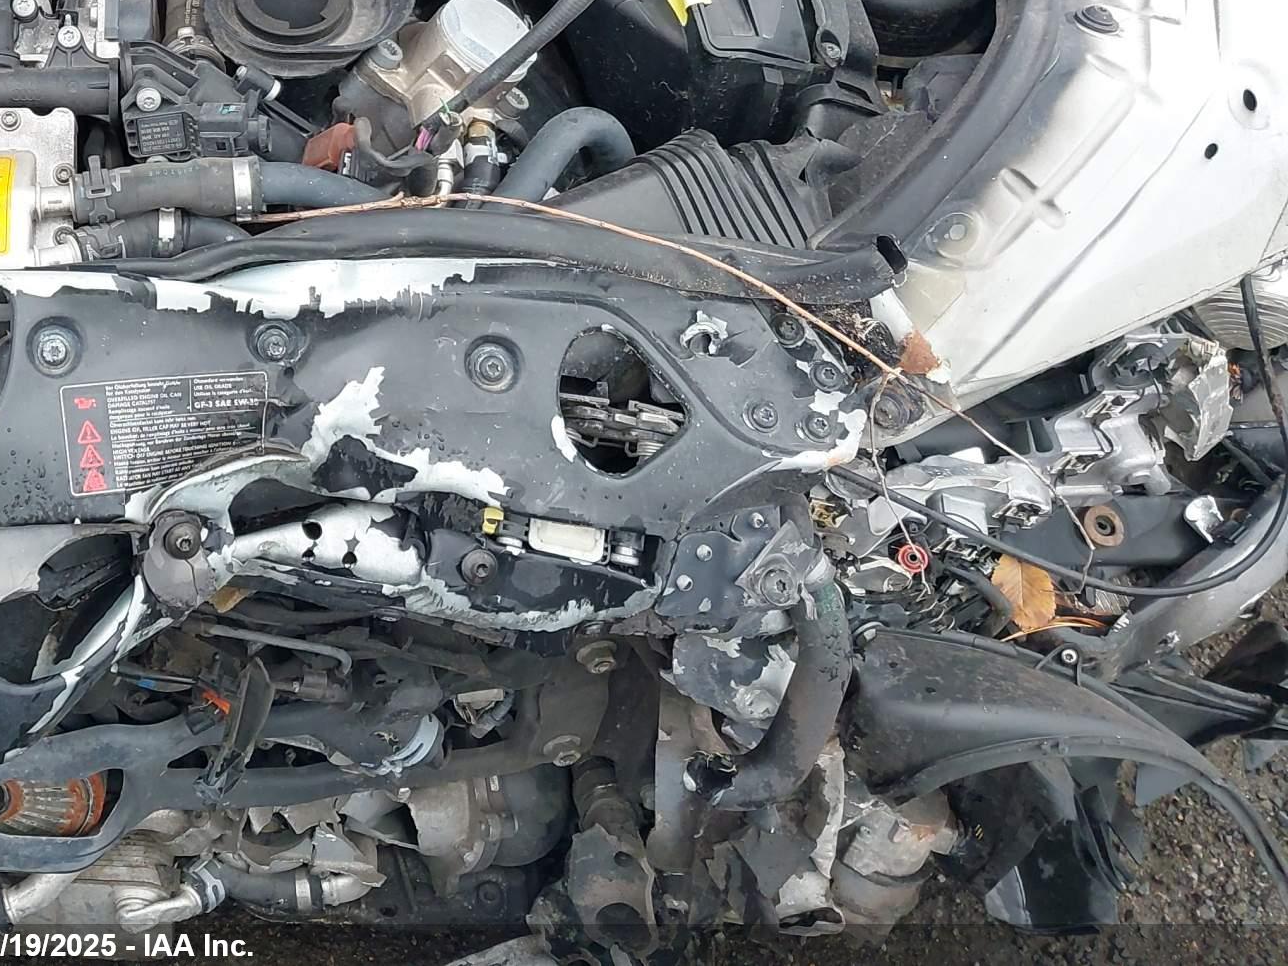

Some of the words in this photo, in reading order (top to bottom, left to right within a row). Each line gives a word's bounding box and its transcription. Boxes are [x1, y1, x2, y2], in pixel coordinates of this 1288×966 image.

[132, 399, 156, 407] CATALYST
[193, 401, 213, 409] GF-3
[215, 399, 231, 407] SAE
[110, 427, 133, 435] ENGINE
